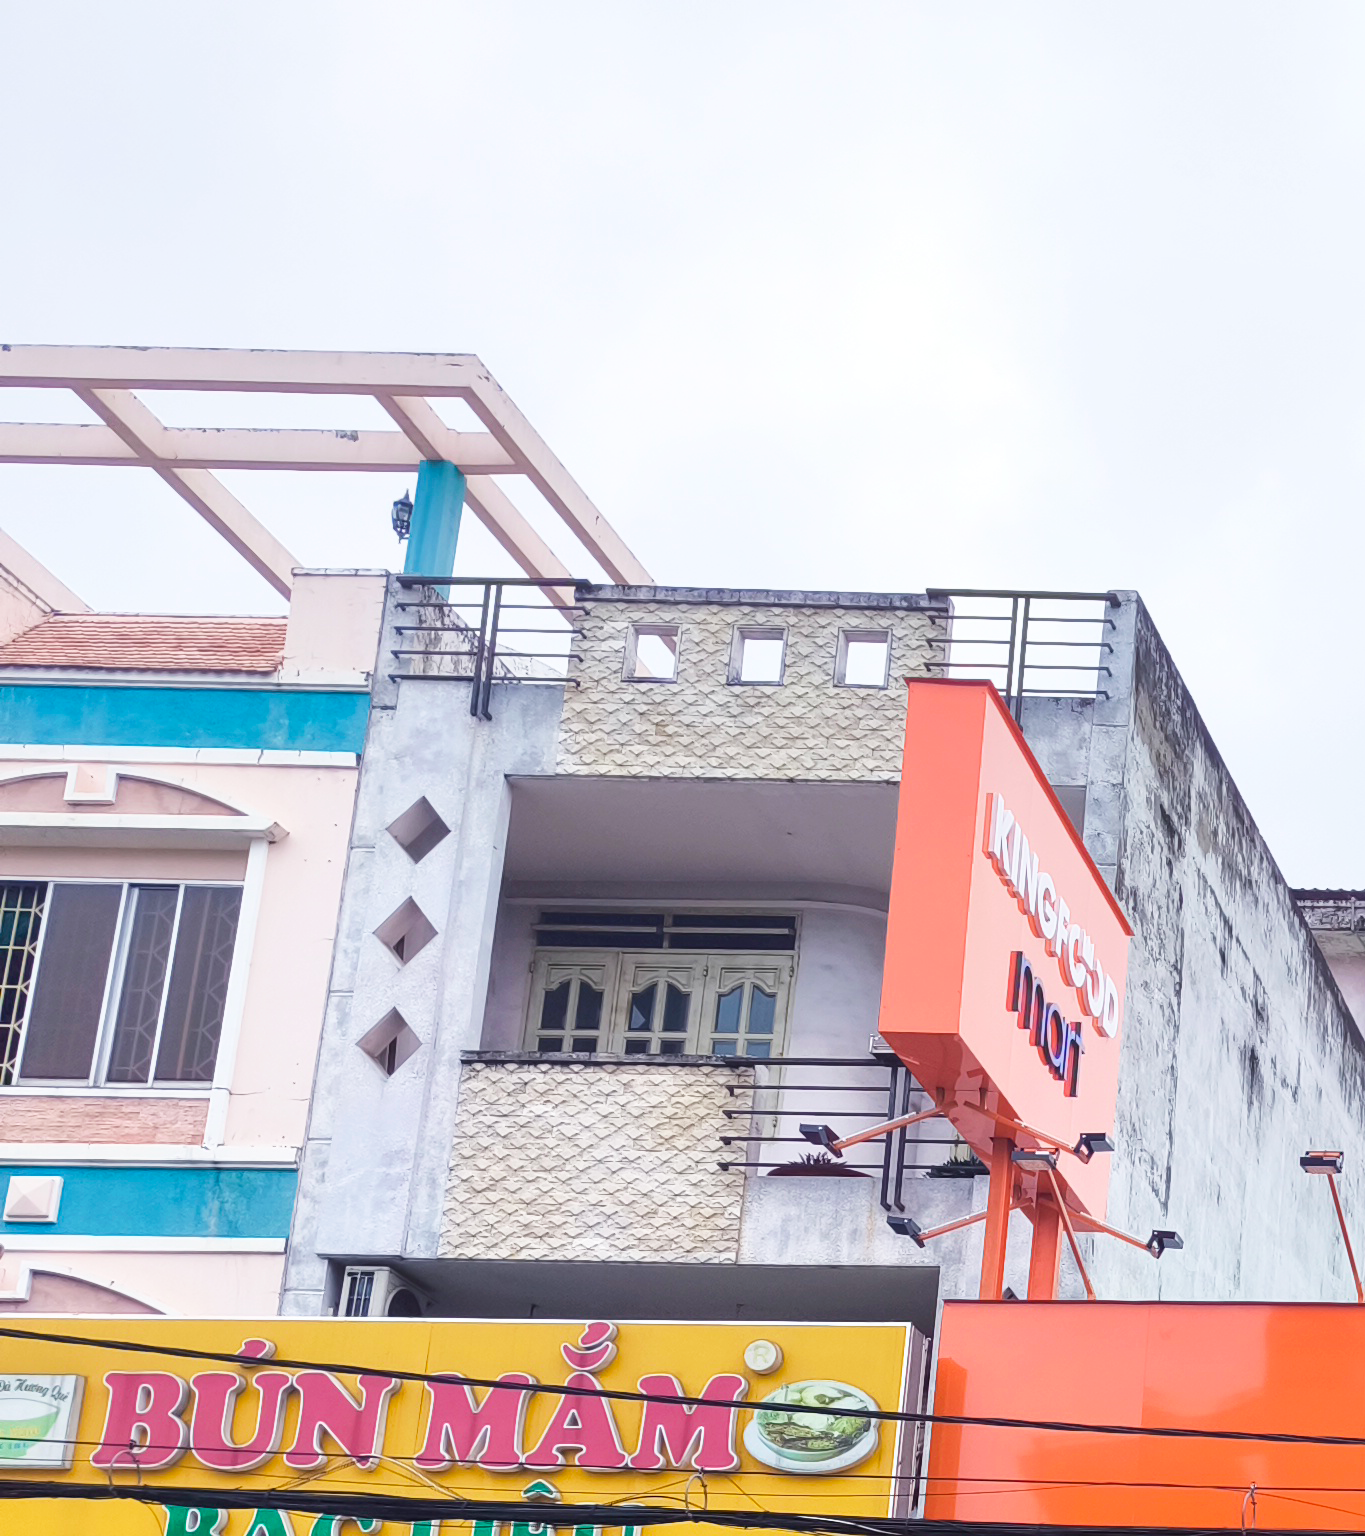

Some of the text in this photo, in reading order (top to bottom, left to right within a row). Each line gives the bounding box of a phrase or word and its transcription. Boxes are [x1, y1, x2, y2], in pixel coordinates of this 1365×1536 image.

[1009, 950, 1085, 1098] mart
[90, 1321, 749, 1474] BÚN MẮM
